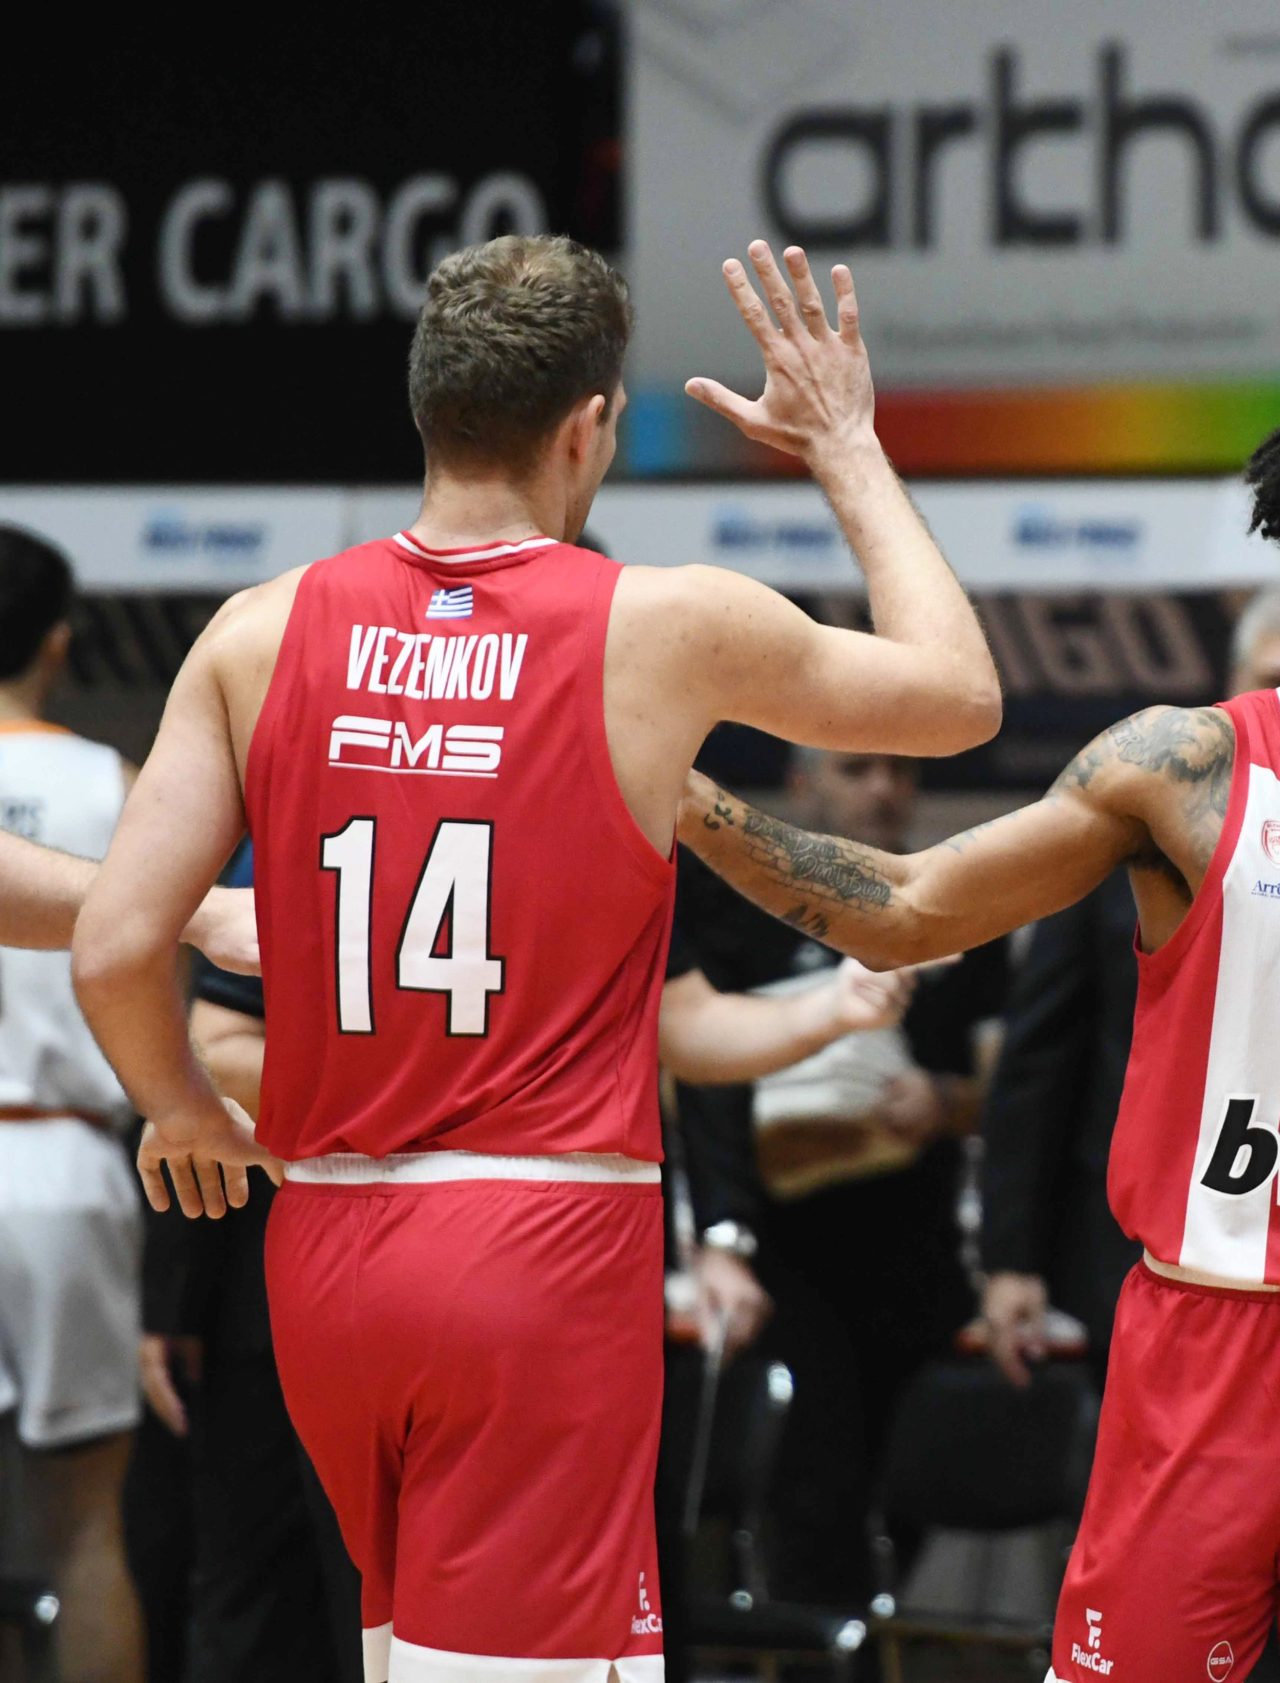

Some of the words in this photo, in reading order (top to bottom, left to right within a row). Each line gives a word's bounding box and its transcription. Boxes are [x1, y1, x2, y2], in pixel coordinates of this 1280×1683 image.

[346, 624, 529, 700] VEZENKOV
[328, 715, 505, 778] FMS
[319, 815, 506, 1037] 14
[1071, 1642, 1114, 1676] FlexCar
